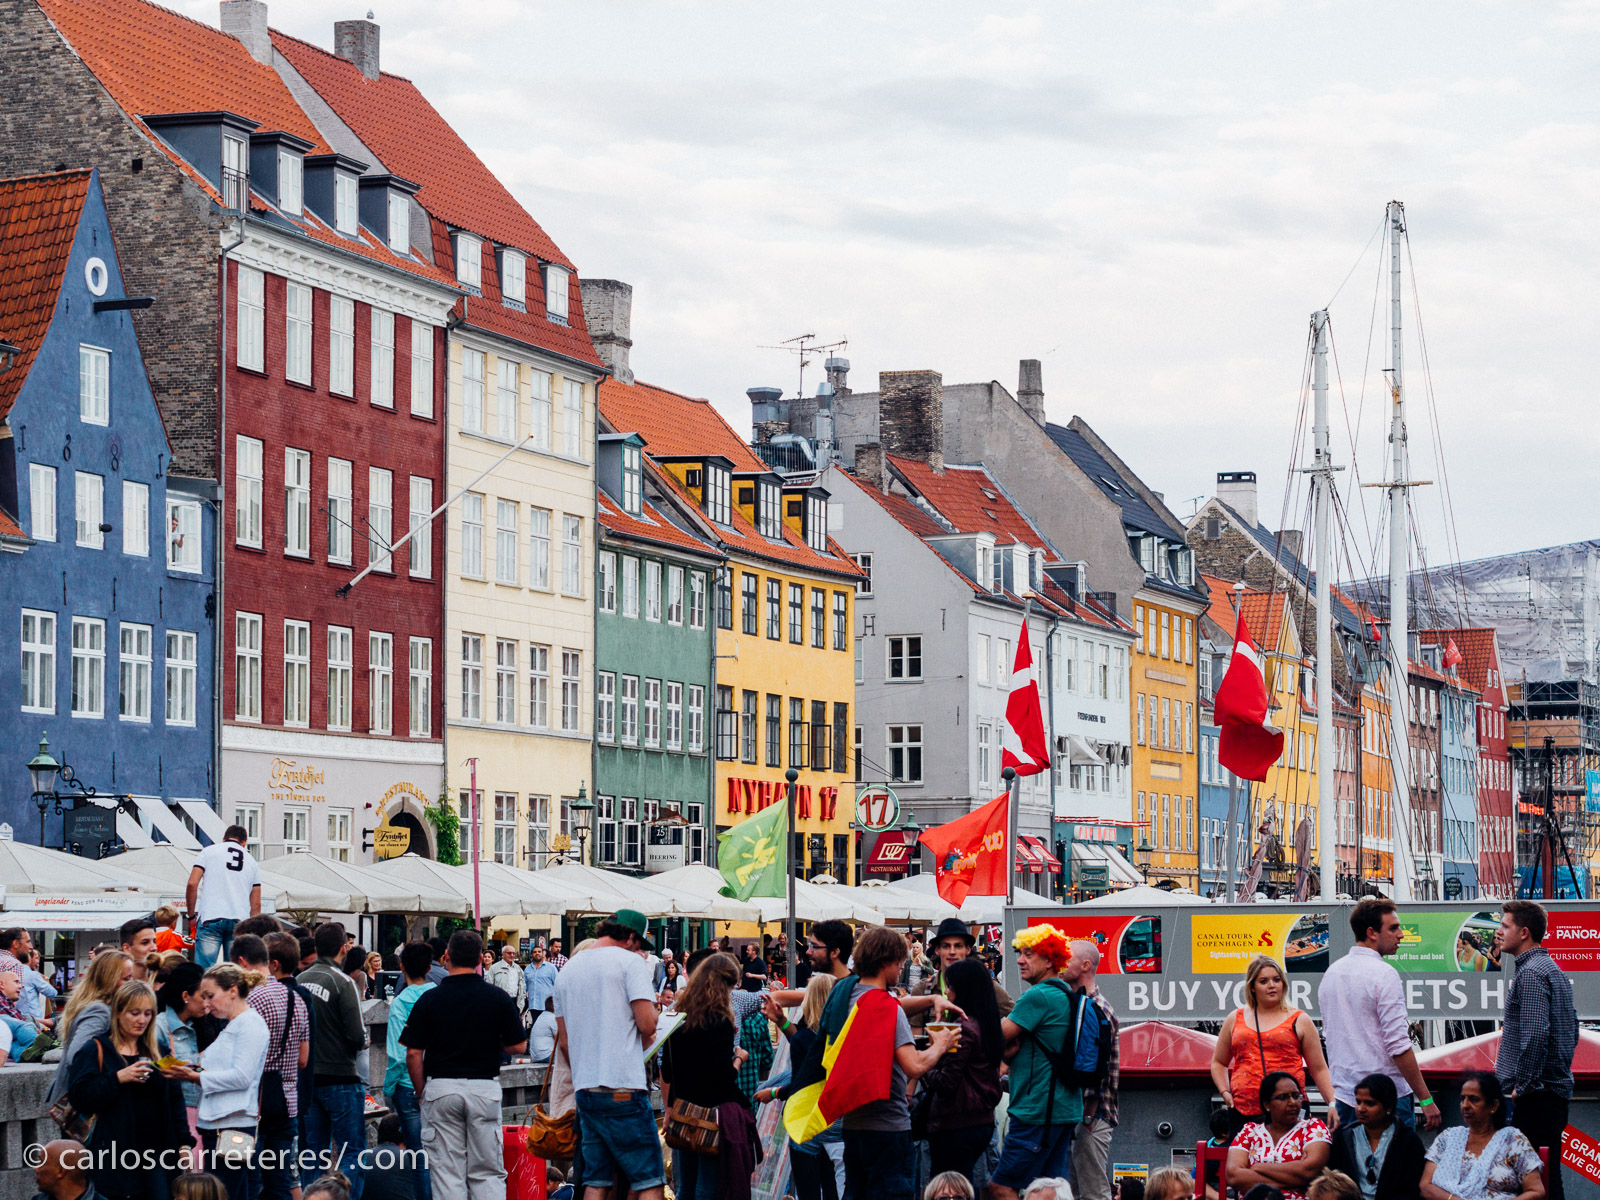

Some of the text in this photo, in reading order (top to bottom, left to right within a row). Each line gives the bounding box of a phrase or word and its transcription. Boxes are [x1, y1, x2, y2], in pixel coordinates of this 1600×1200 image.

[379, 781, 431, 810] RESTAURANT
[818, 786, 839, 820] 17
[859, 794, 890, 826] 17
[226, 846, 244, 872] 3
[1556, 929, 1600, 939] PANOR
[1210, 951, 1241, 960] Sightseeing
[1241, 951, 1249, 960] by
[1549, 952, 1593, 961] CURSIONS
[1128, 980, 1201, 1011] BUY
[1211, 980, 1313, 1011] YR
[1400, 979, 1469, 1010] ETS
[1560, 1130, 1570, 1144] E
[1562, 1149, 1586, 1169] LIVE
